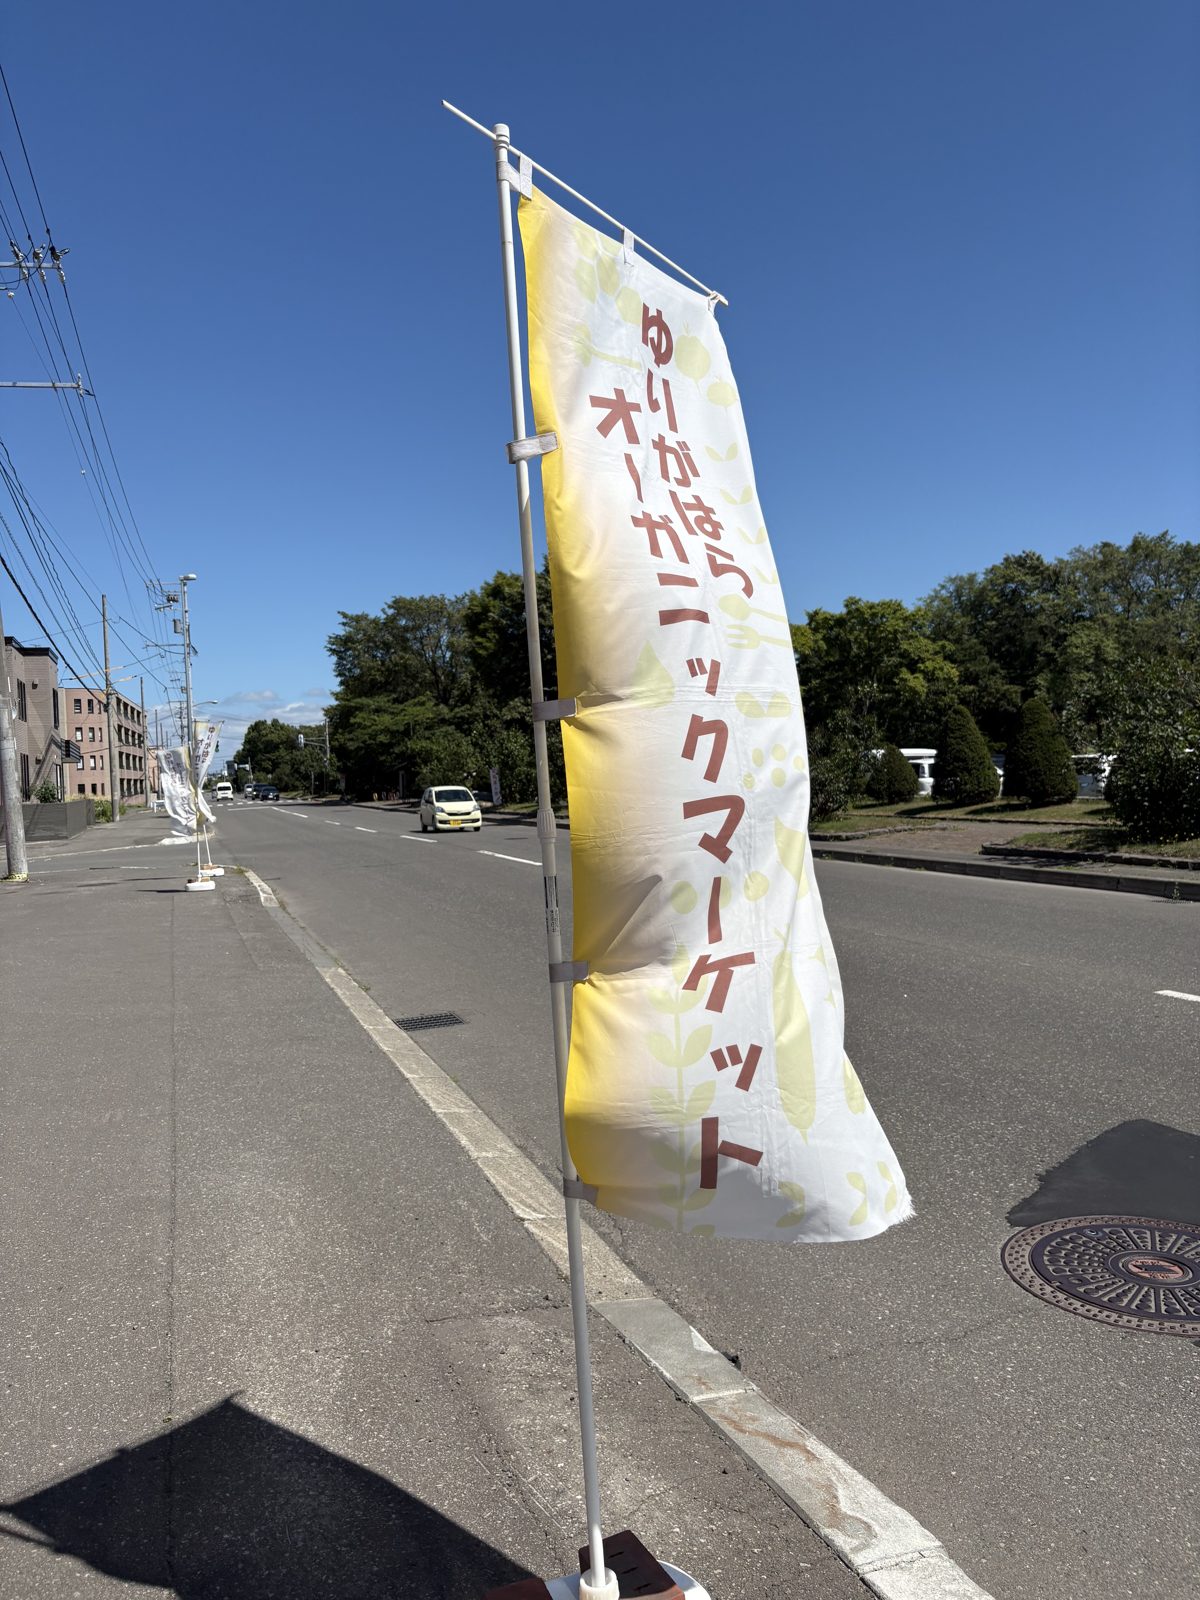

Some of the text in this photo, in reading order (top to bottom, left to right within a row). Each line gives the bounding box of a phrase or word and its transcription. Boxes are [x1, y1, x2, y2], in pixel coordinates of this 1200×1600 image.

[641, 302, 754, 599] ゆりがはら
[588, 387, 763, 1189] オーガニックマーケット
